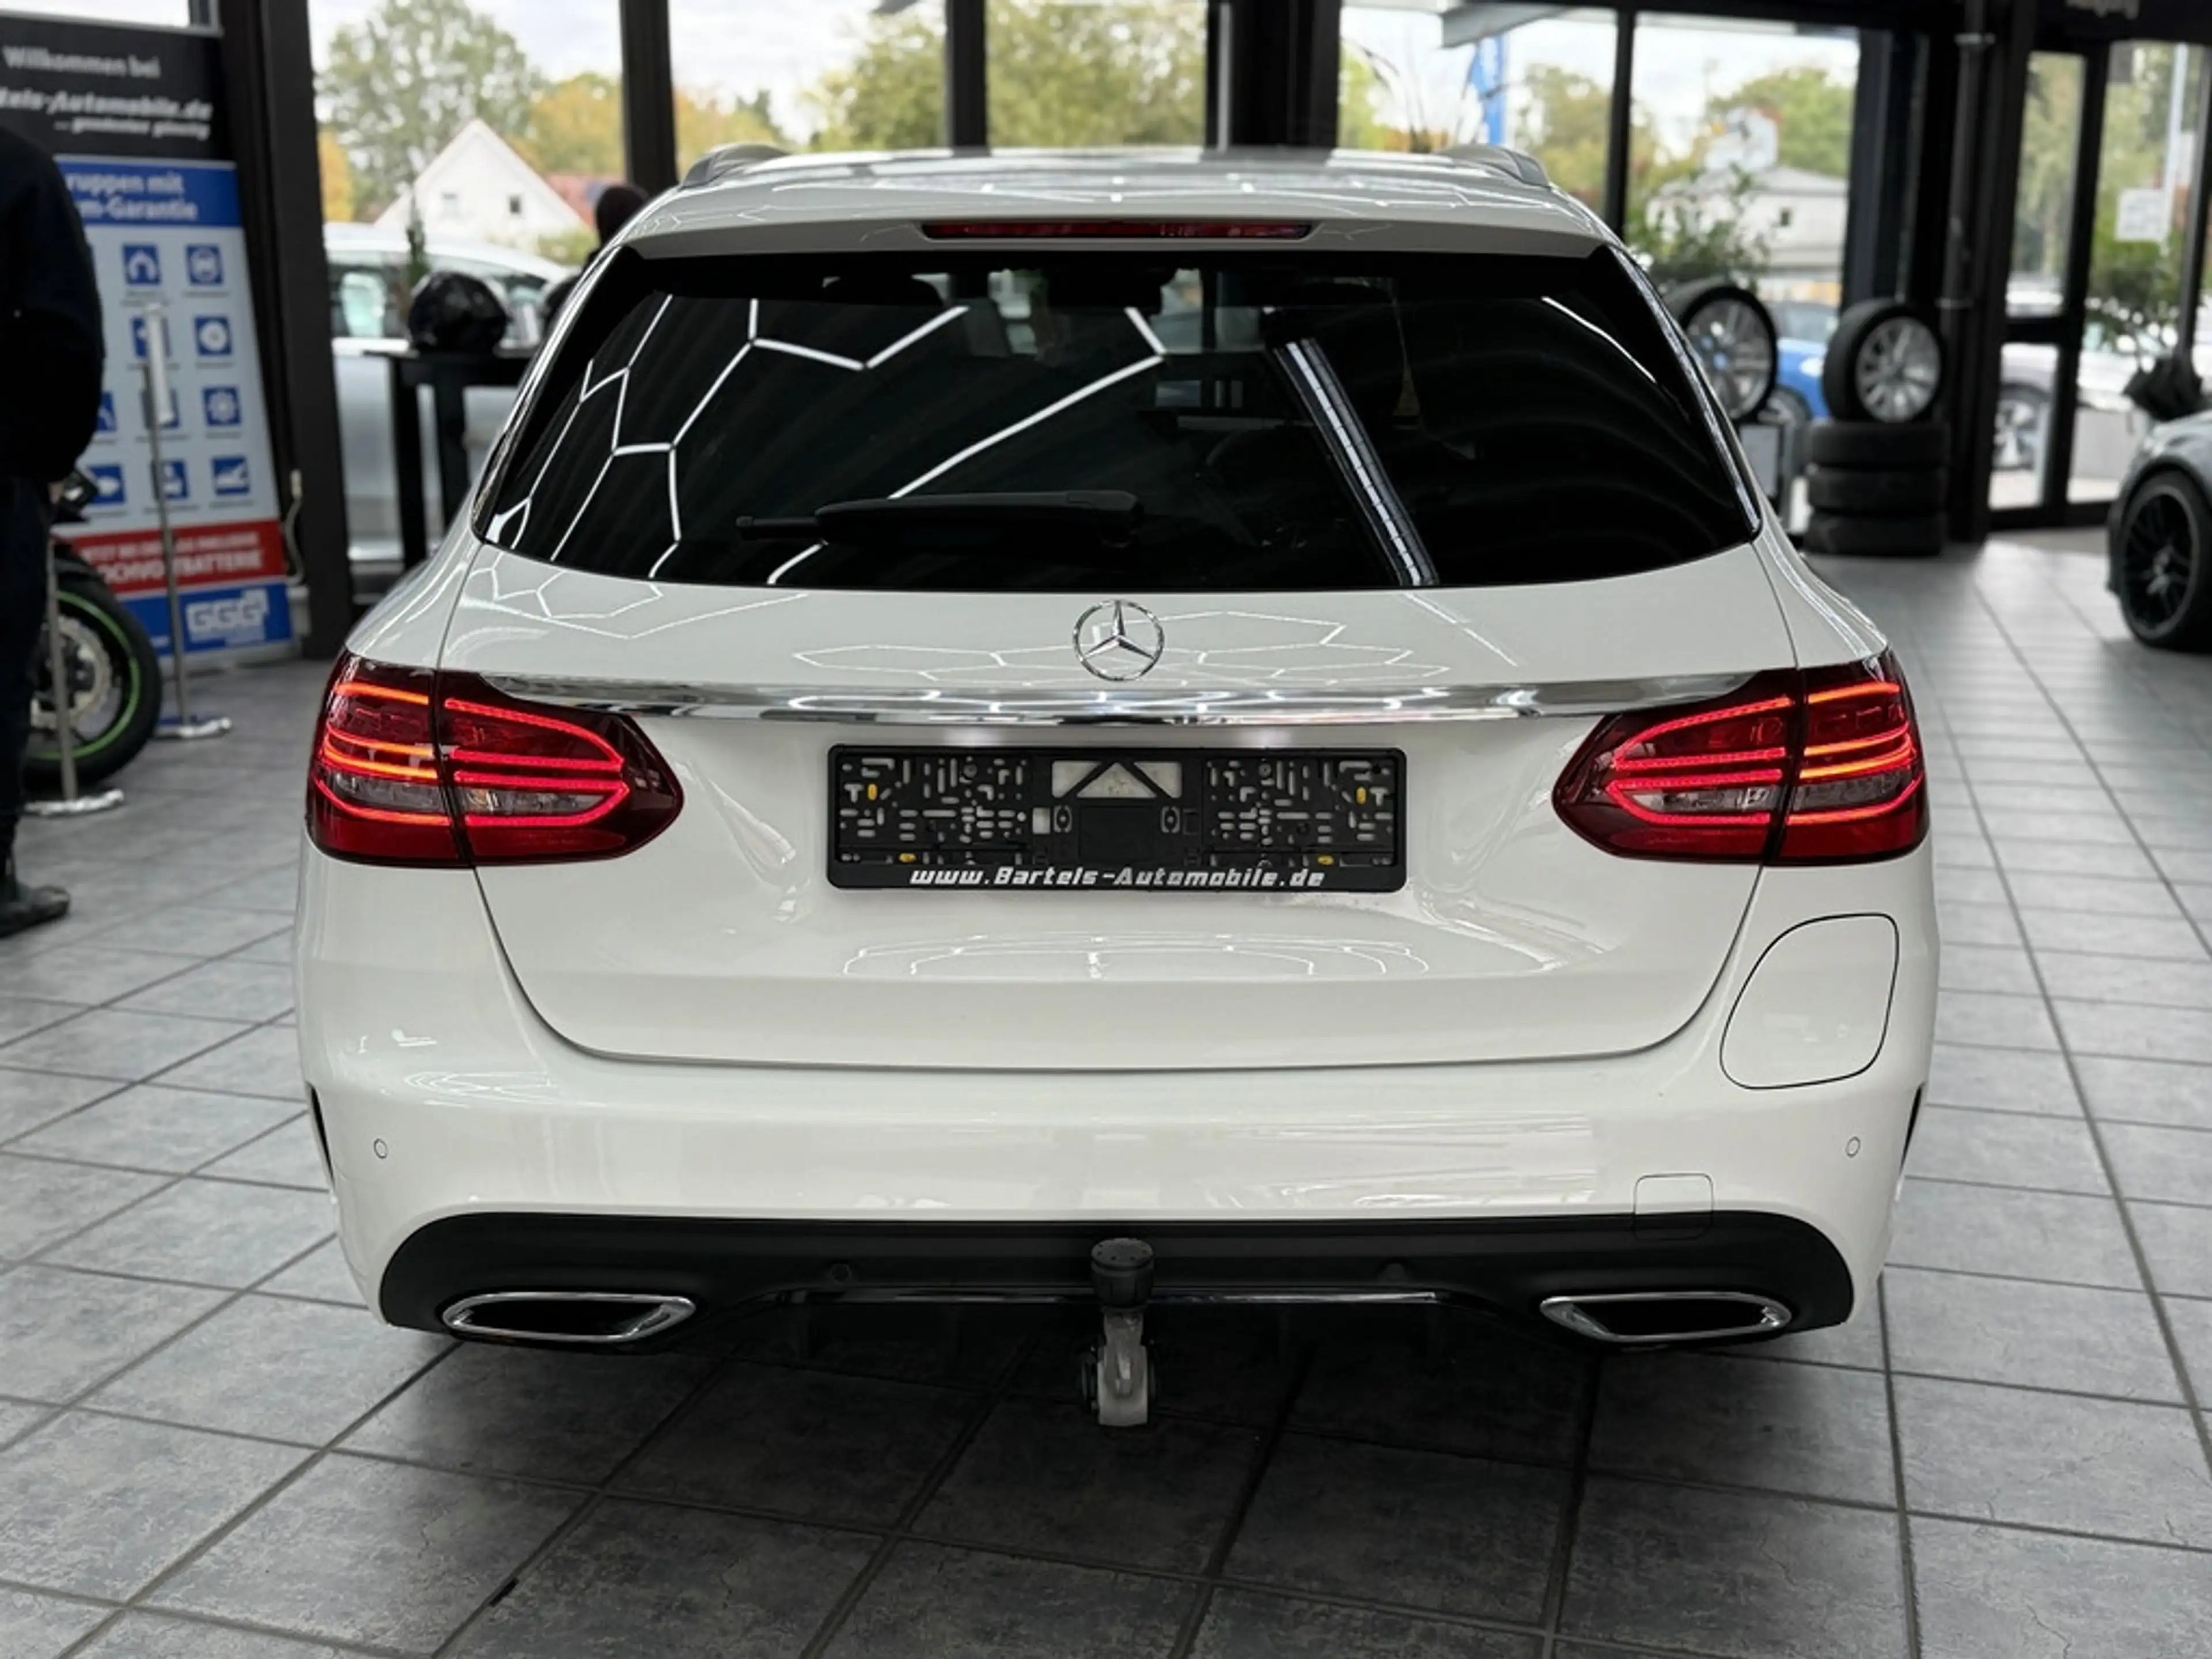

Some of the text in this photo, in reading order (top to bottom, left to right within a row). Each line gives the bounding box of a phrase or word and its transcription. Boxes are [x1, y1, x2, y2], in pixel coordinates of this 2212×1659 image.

[3, 47, 161, 79] Willkommen bei
[66, 173, 143, 196] ruppen
[910, 866, 1324, 888] www.Bartels-Automobile.de
